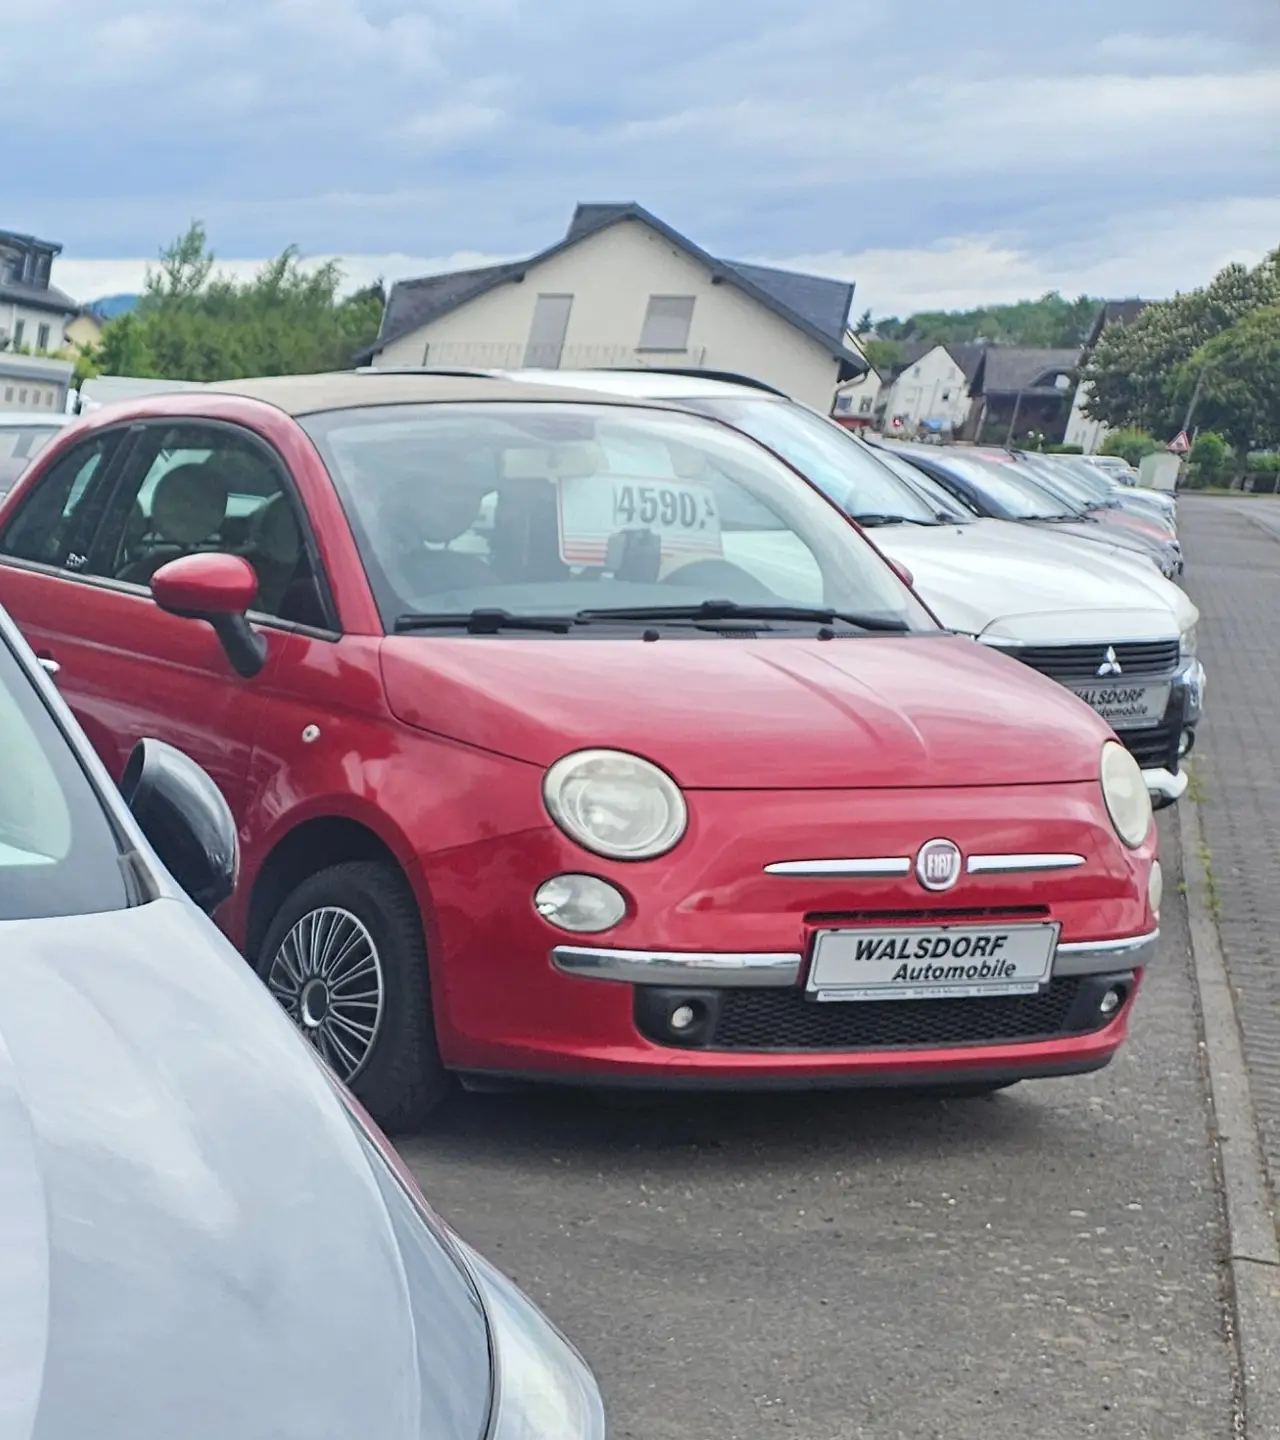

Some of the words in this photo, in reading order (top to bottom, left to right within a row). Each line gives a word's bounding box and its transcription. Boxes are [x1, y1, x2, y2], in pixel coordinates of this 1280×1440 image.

[927, 853, 954, 879] FIAT
[854, 935, 1009, 962] WALSDORF
[891, 958, 1017, 982] Automobile
